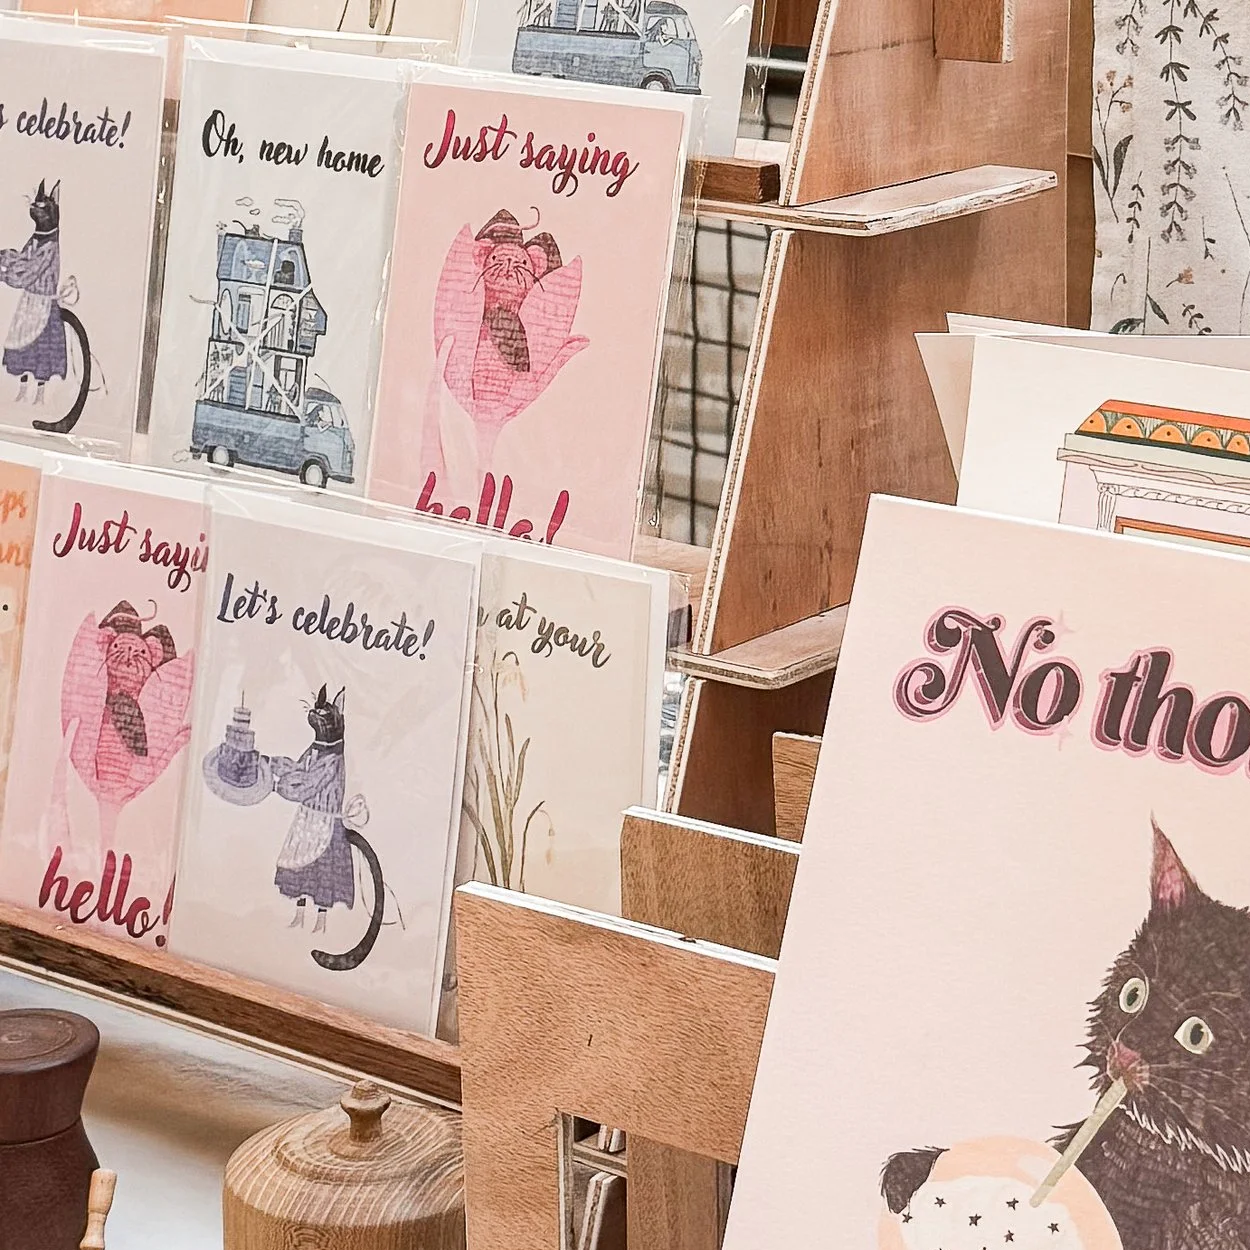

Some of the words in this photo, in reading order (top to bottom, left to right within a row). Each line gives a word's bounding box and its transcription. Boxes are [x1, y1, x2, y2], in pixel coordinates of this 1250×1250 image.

[16, 96, 132, 149] celebrate!
[202, 109, 244, 164] Oh,
[259, 139, 308, 166] new
[316, 135, 385, 178] home
[423, 108, 518, 169] Just
[519, 131, 640, 198] saying
[53, 502, 138, 558] Just
[217, 572, 283, 625] Let's
[292, 594, 435, 661] celebrate!
[496, 592, 538, 631] at
[530, 616, 612, 668] your
[893, 605, 1083, 731] No
